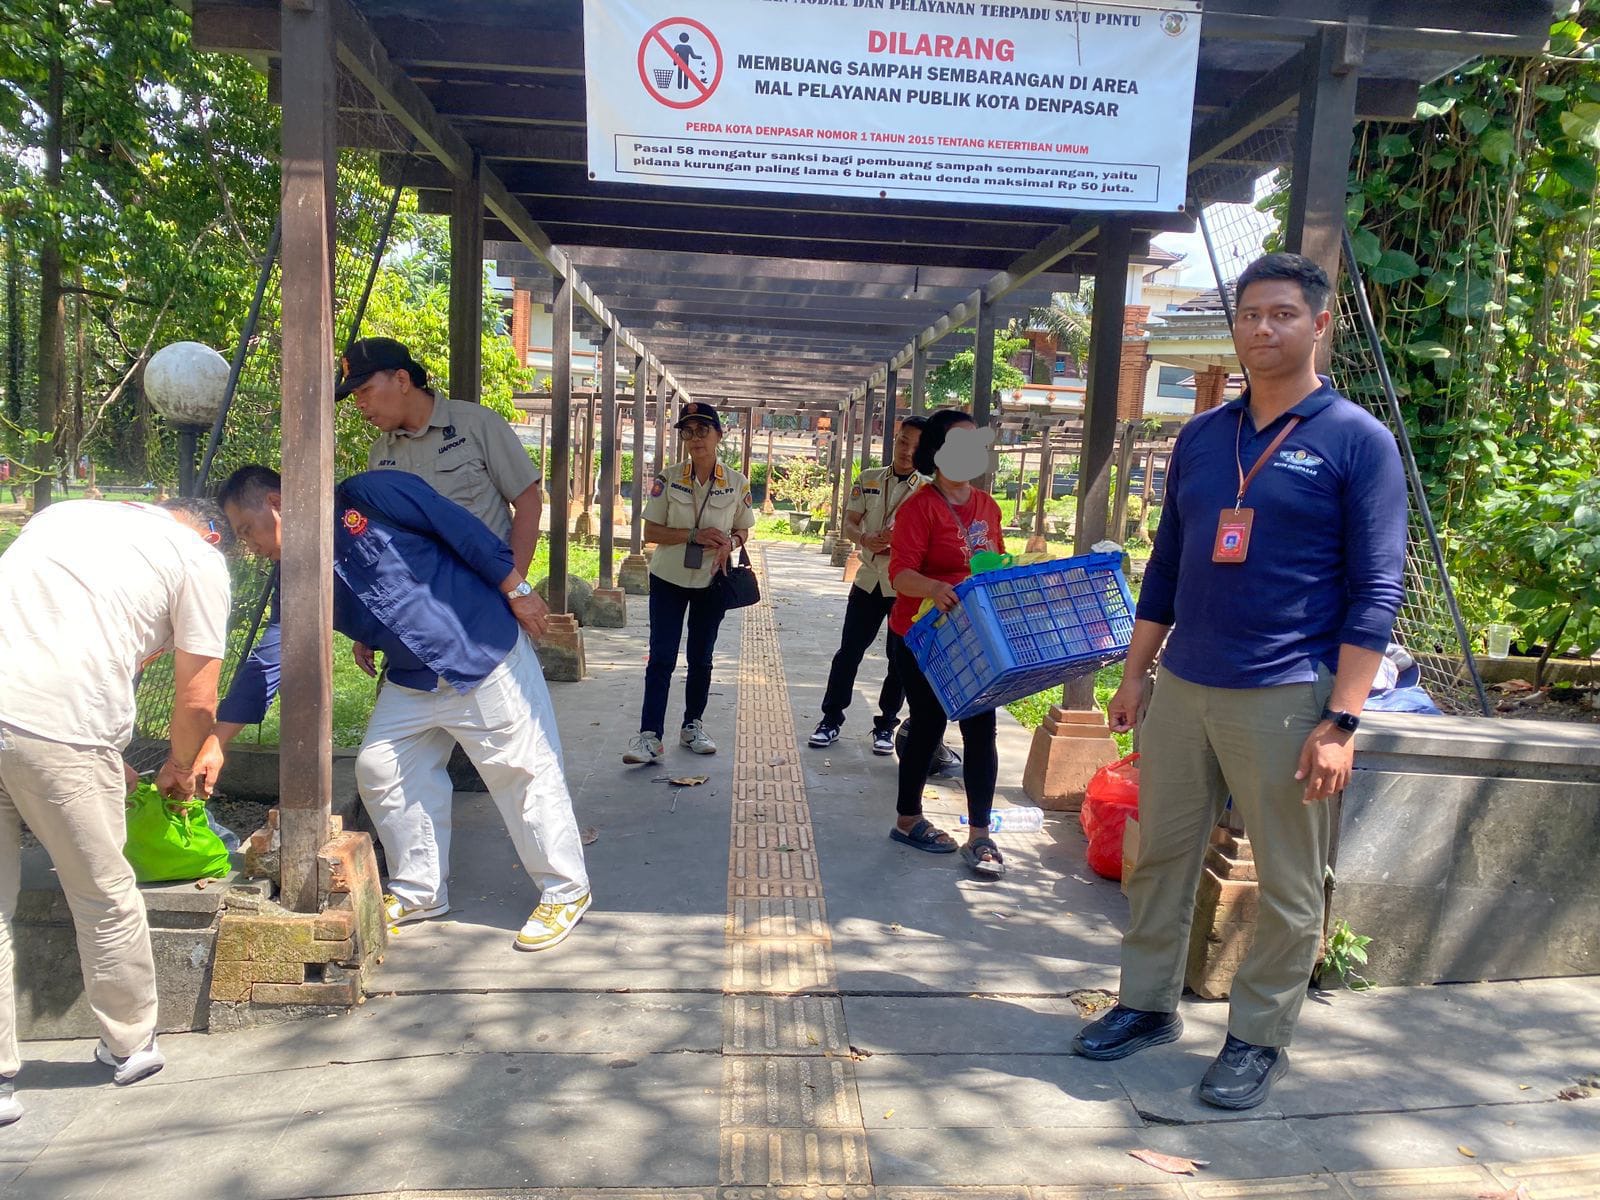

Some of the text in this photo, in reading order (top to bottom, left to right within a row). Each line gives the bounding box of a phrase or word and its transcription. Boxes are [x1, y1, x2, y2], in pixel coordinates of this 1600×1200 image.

[889, 0, 975, 15] PELAYANAN
[981, 4, 1050, 21] TERPADU
[1055, 9, 1090, 24] SATU
[1095, 12, 1141, 27] PINTU
[868, 30, 1015, 62] DILARANG
[737, 54, 1139, 95] MEMBUANG SAMPAH SEMBARANGAN DI AREA
[755, 79, 1119, 117] MAL PELAYANAN PUBLIK KOTA DENPASAR
[686, 122, 1089, 155] PERDA KOTA DENPASAR NOMOR 1 TAHUN 2015 TENTANG KETERTIBAN UMUM
[633, 143, 1138, 181] Pasal 58 mengatur sanksi bagi pembuang sampah sembarangan, yaitu
[633, 156, 1134, 193] pidana kurungan paling lama 6 bulan atau denda maksimal Rp 50 juta.
